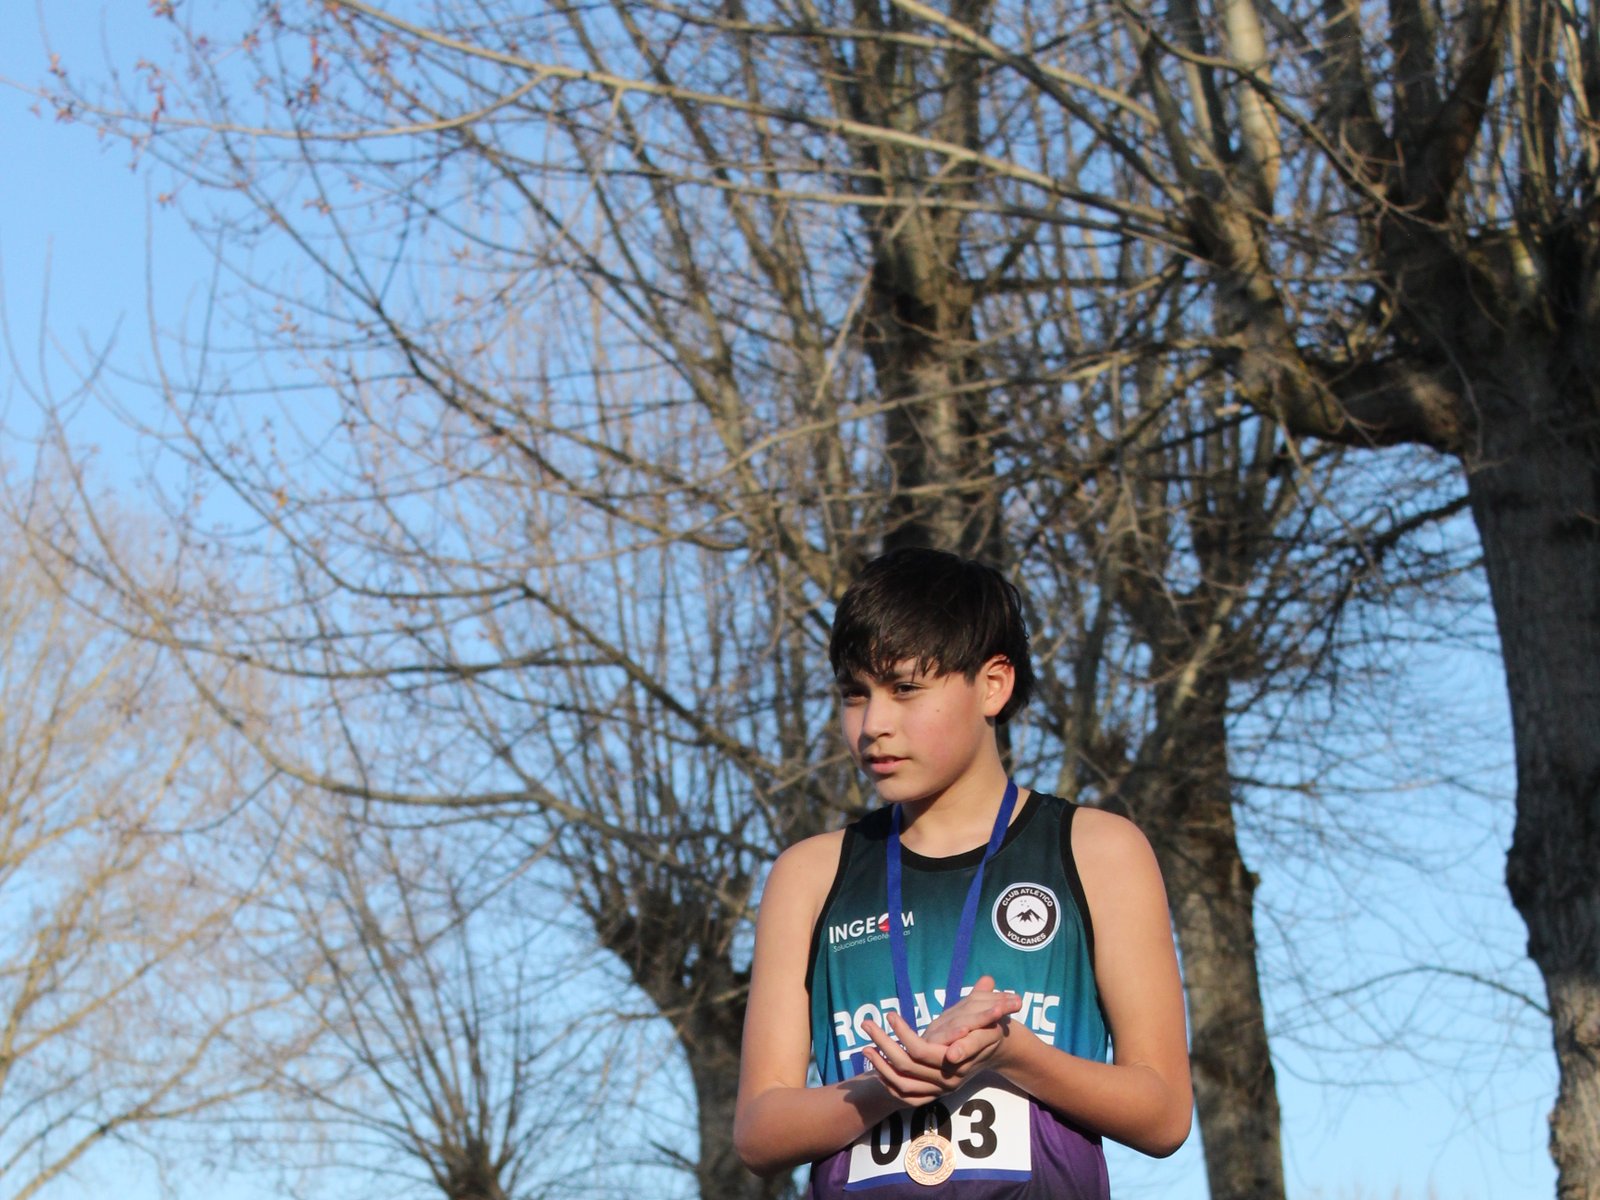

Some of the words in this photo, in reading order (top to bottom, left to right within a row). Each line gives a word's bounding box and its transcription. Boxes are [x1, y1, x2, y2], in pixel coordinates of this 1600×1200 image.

[1002, 890, 1020, 906] CLUB
[1007, 930, 1047, 944] VOLCANES
[833, 938, 866, 953] Soluciones
